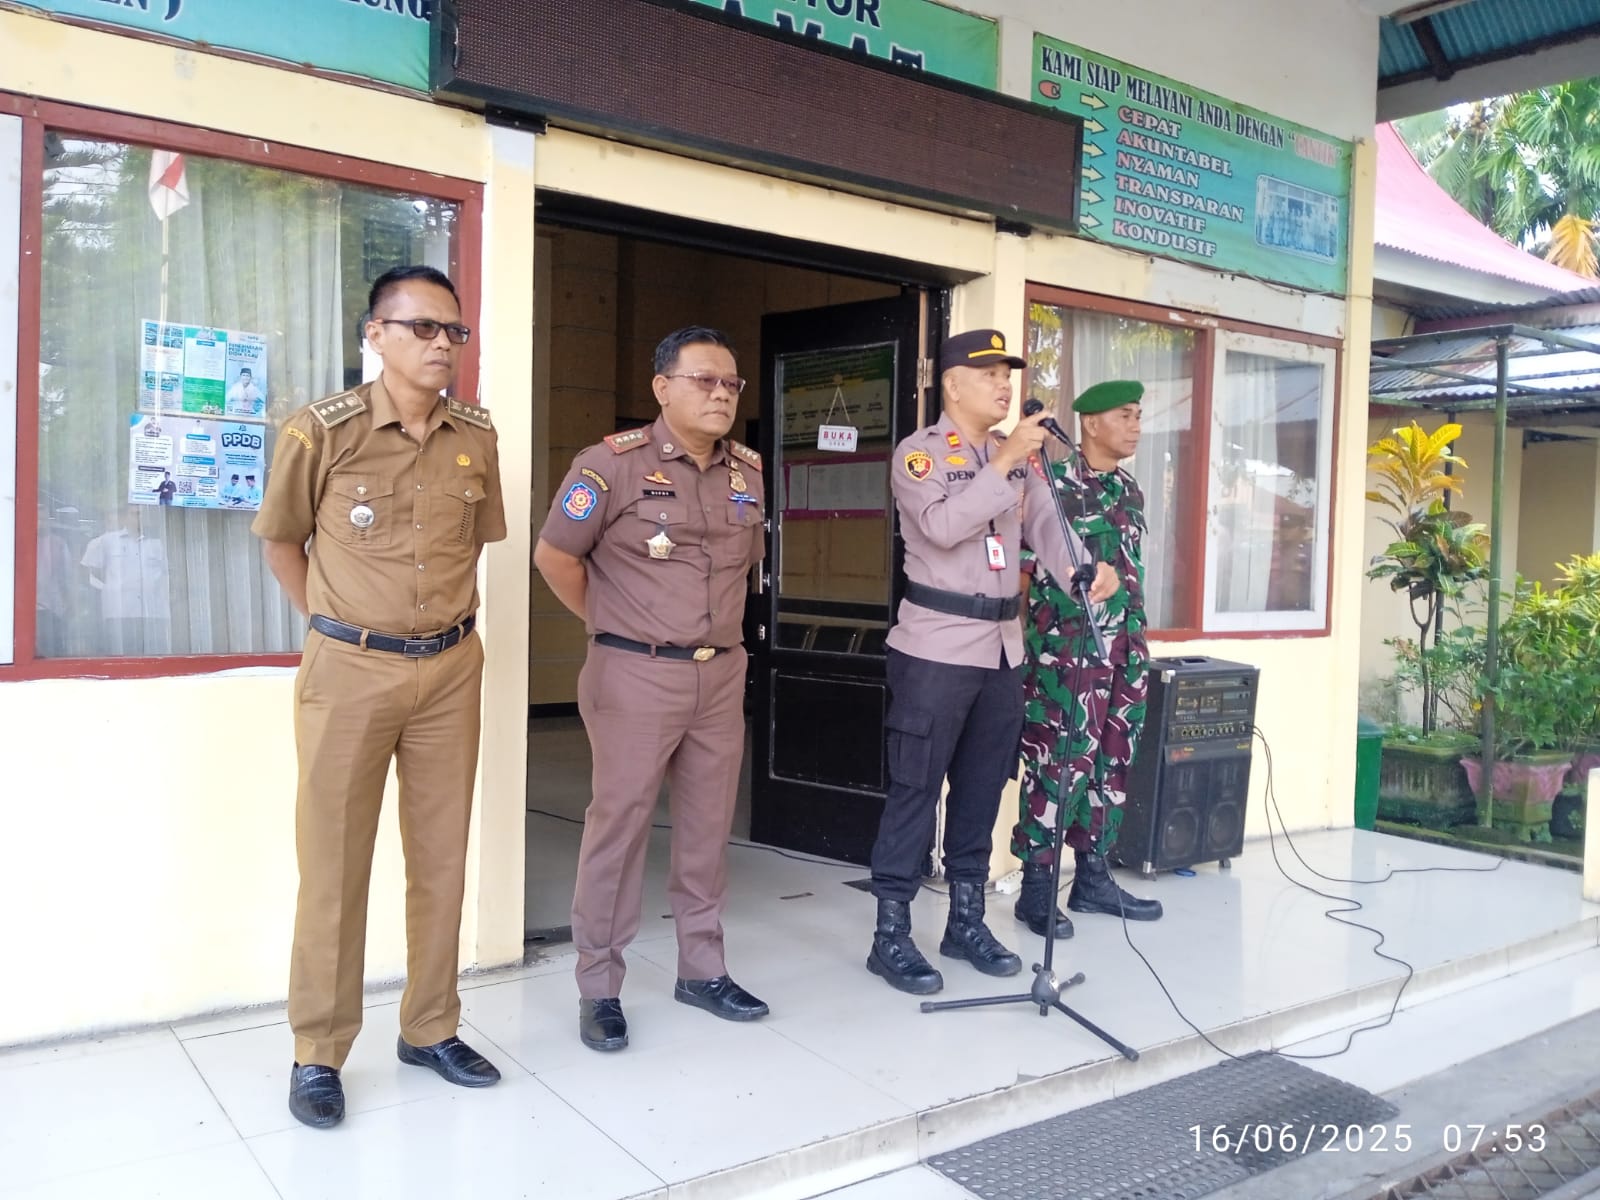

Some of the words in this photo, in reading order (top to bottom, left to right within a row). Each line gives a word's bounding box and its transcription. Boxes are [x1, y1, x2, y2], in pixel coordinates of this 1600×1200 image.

[1041, 46, 1082, 82] KAMI
[1086, 62, 1121, 93] SIAP
[1126, 74, 1193, 119] MELAYANI
[1197, 99, 1232, 132] ANDA
[1235, 114, 1285, 149] DENGAN
[1117, 106, 1182, 138] CEPAT
[1116, 129, 1233, 177] AKUNTABEL
[1116, 152, 1199, 188] NYAMAN
[1113, 196, 1207, 232] INOVATIF
[1115, 174, 1245, 222] TRANSPARAN
[1112, 219, 1217, 258] KONDUSIF
[222, 432, 262, 449] PPDB
[823, 430, 852, 441] BUKA
